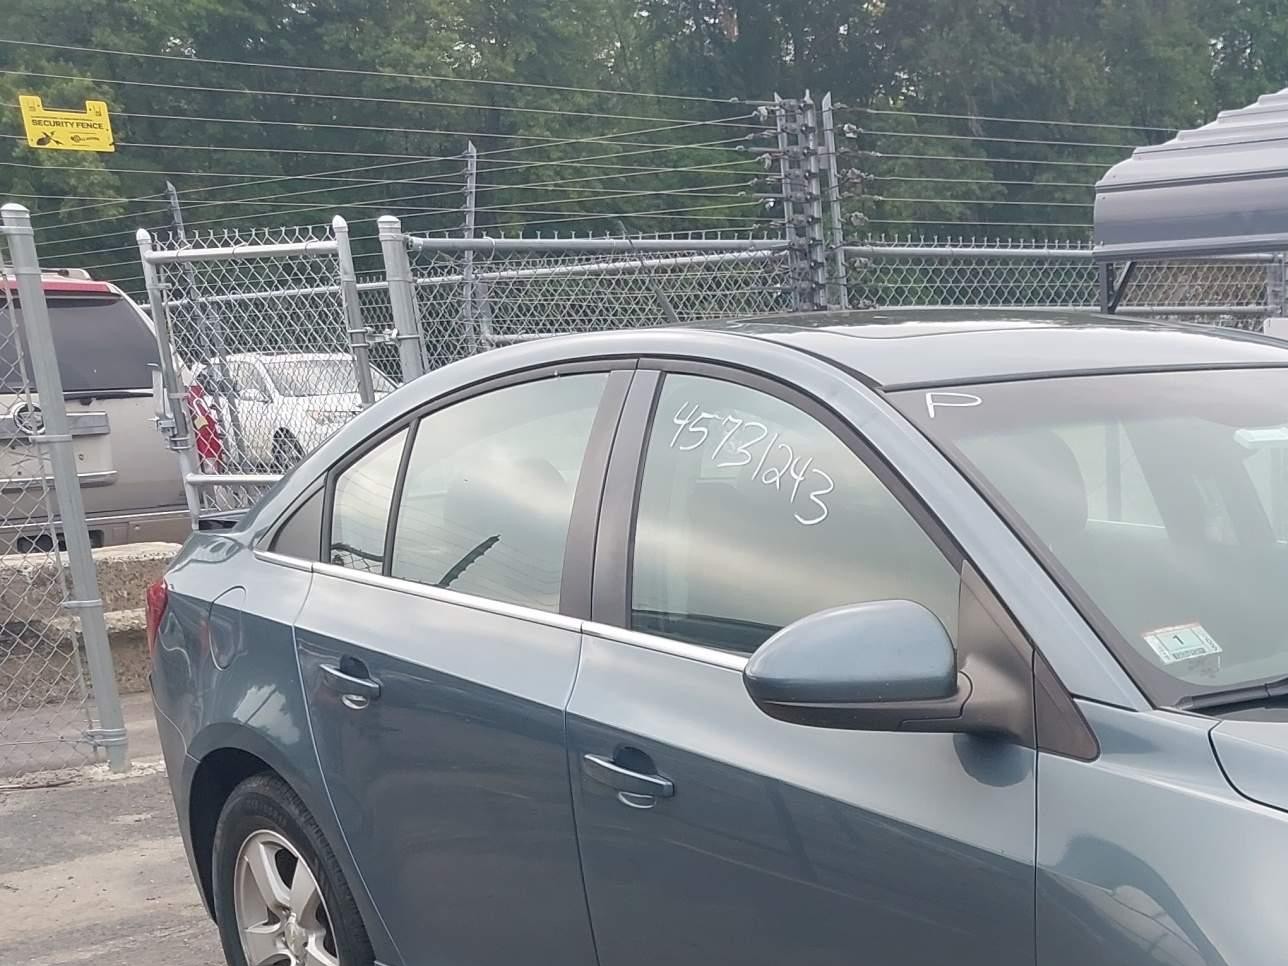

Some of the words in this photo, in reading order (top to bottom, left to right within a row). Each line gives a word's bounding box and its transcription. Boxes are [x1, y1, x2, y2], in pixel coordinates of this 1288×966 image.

[31, 119, 75, 129] SECURITY
[76, 121, 104, 130] FENCE
[926, 392, 982, 418] P
[670, 401, 834, 525] 45731243
